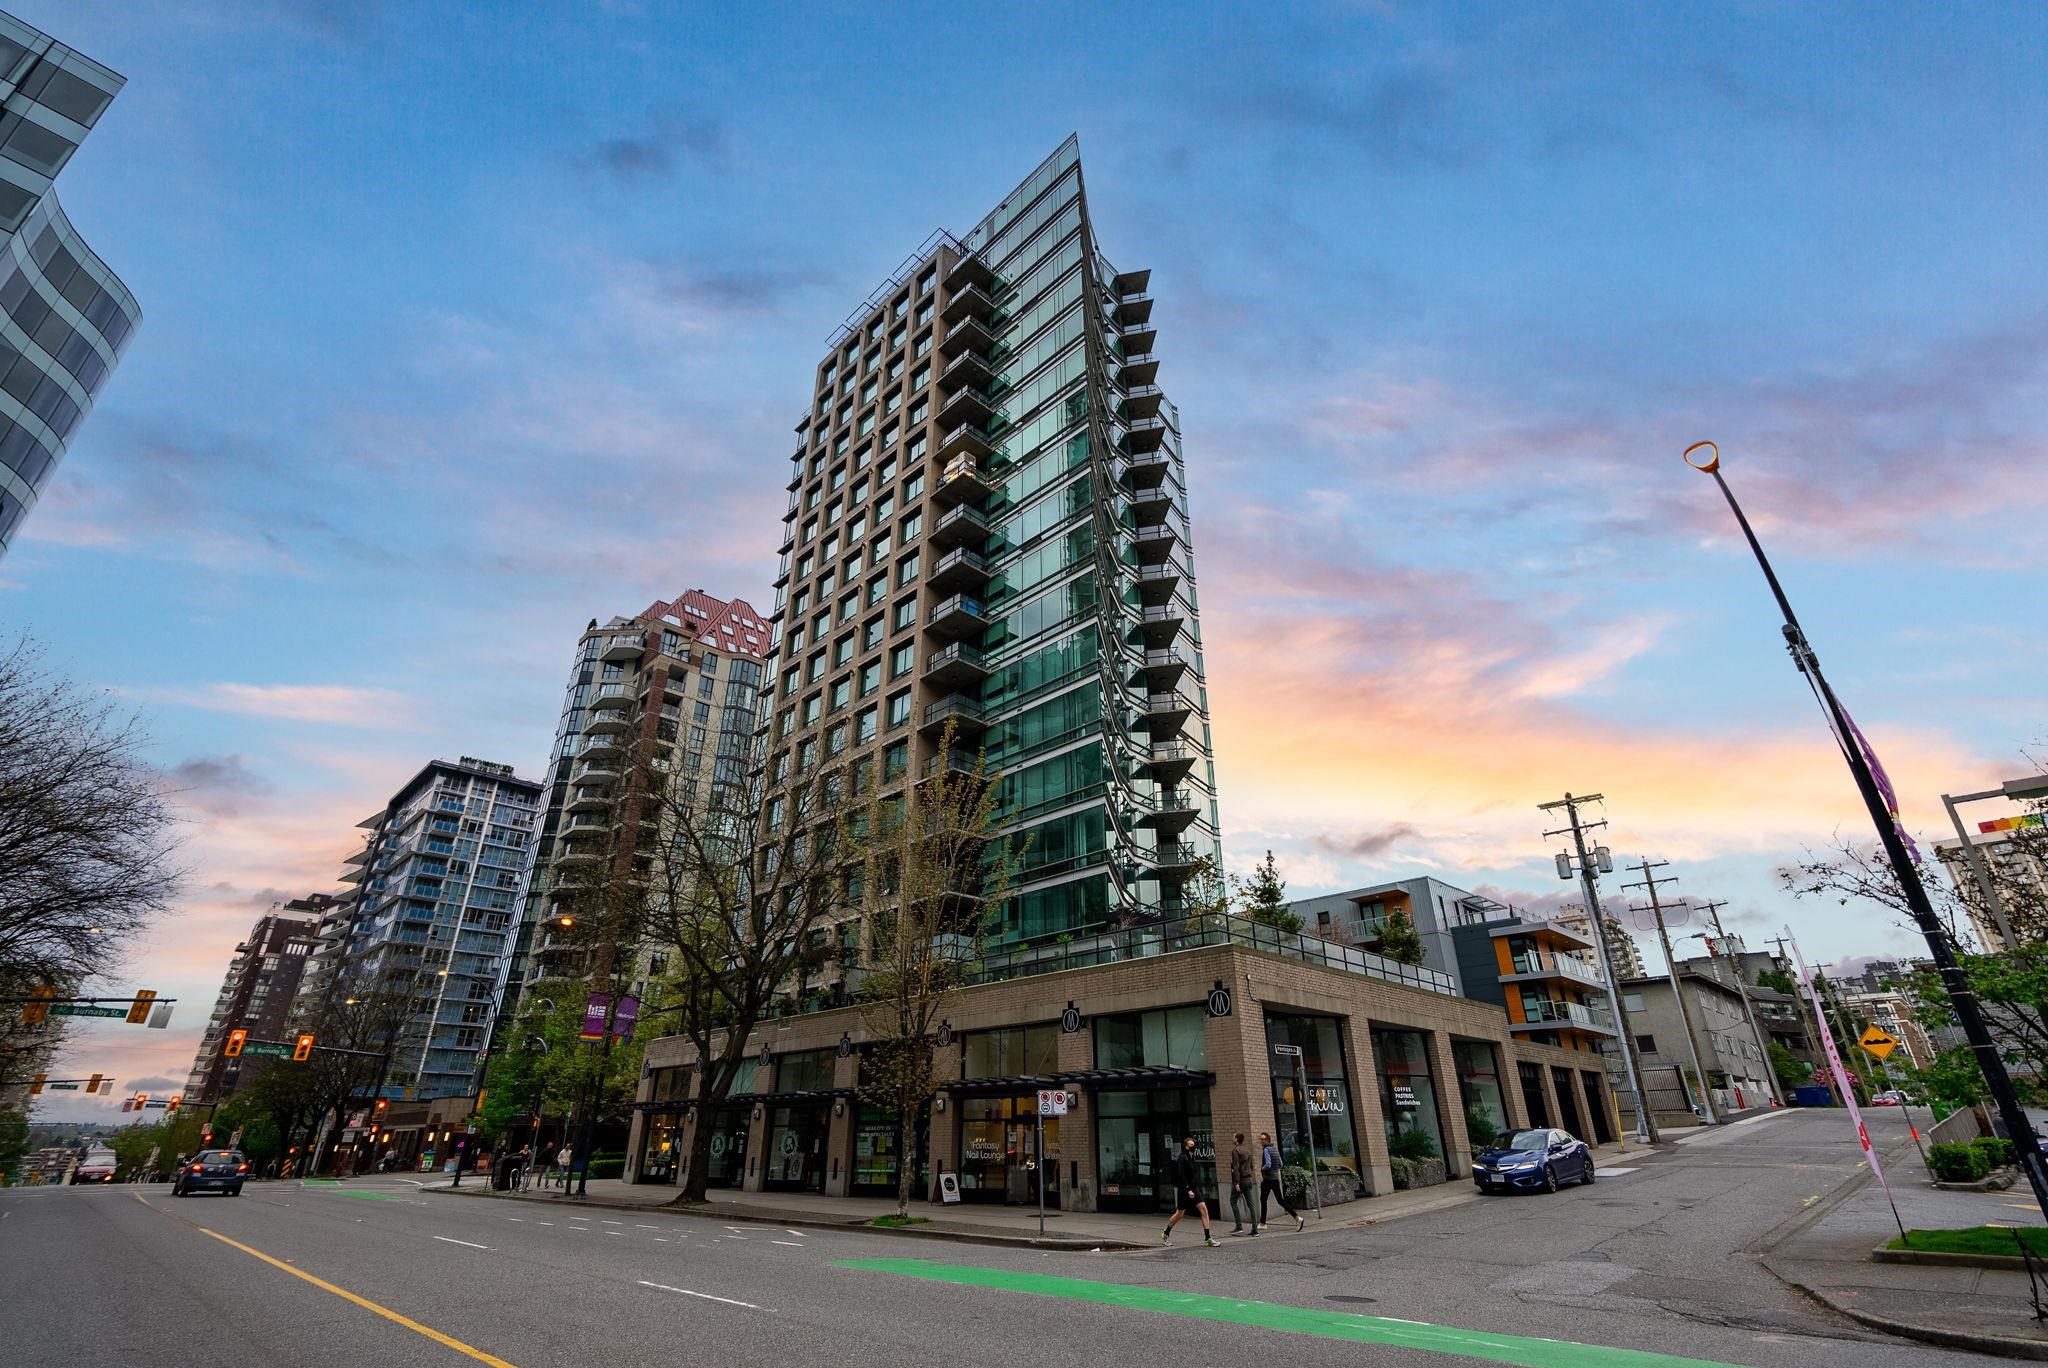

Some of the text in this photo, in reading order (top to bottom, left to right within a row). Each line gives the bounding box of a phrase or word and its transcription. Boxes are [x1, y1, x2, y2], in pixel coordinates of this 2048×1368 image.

[73, 1007, 121, 1017] Burnaby St.
[257, 1047, 280, 1055] Burnaby
[972, 1142, 1000, 1151] Fantasy
[965, 1150, 1006, 1160] Nail Lounge
